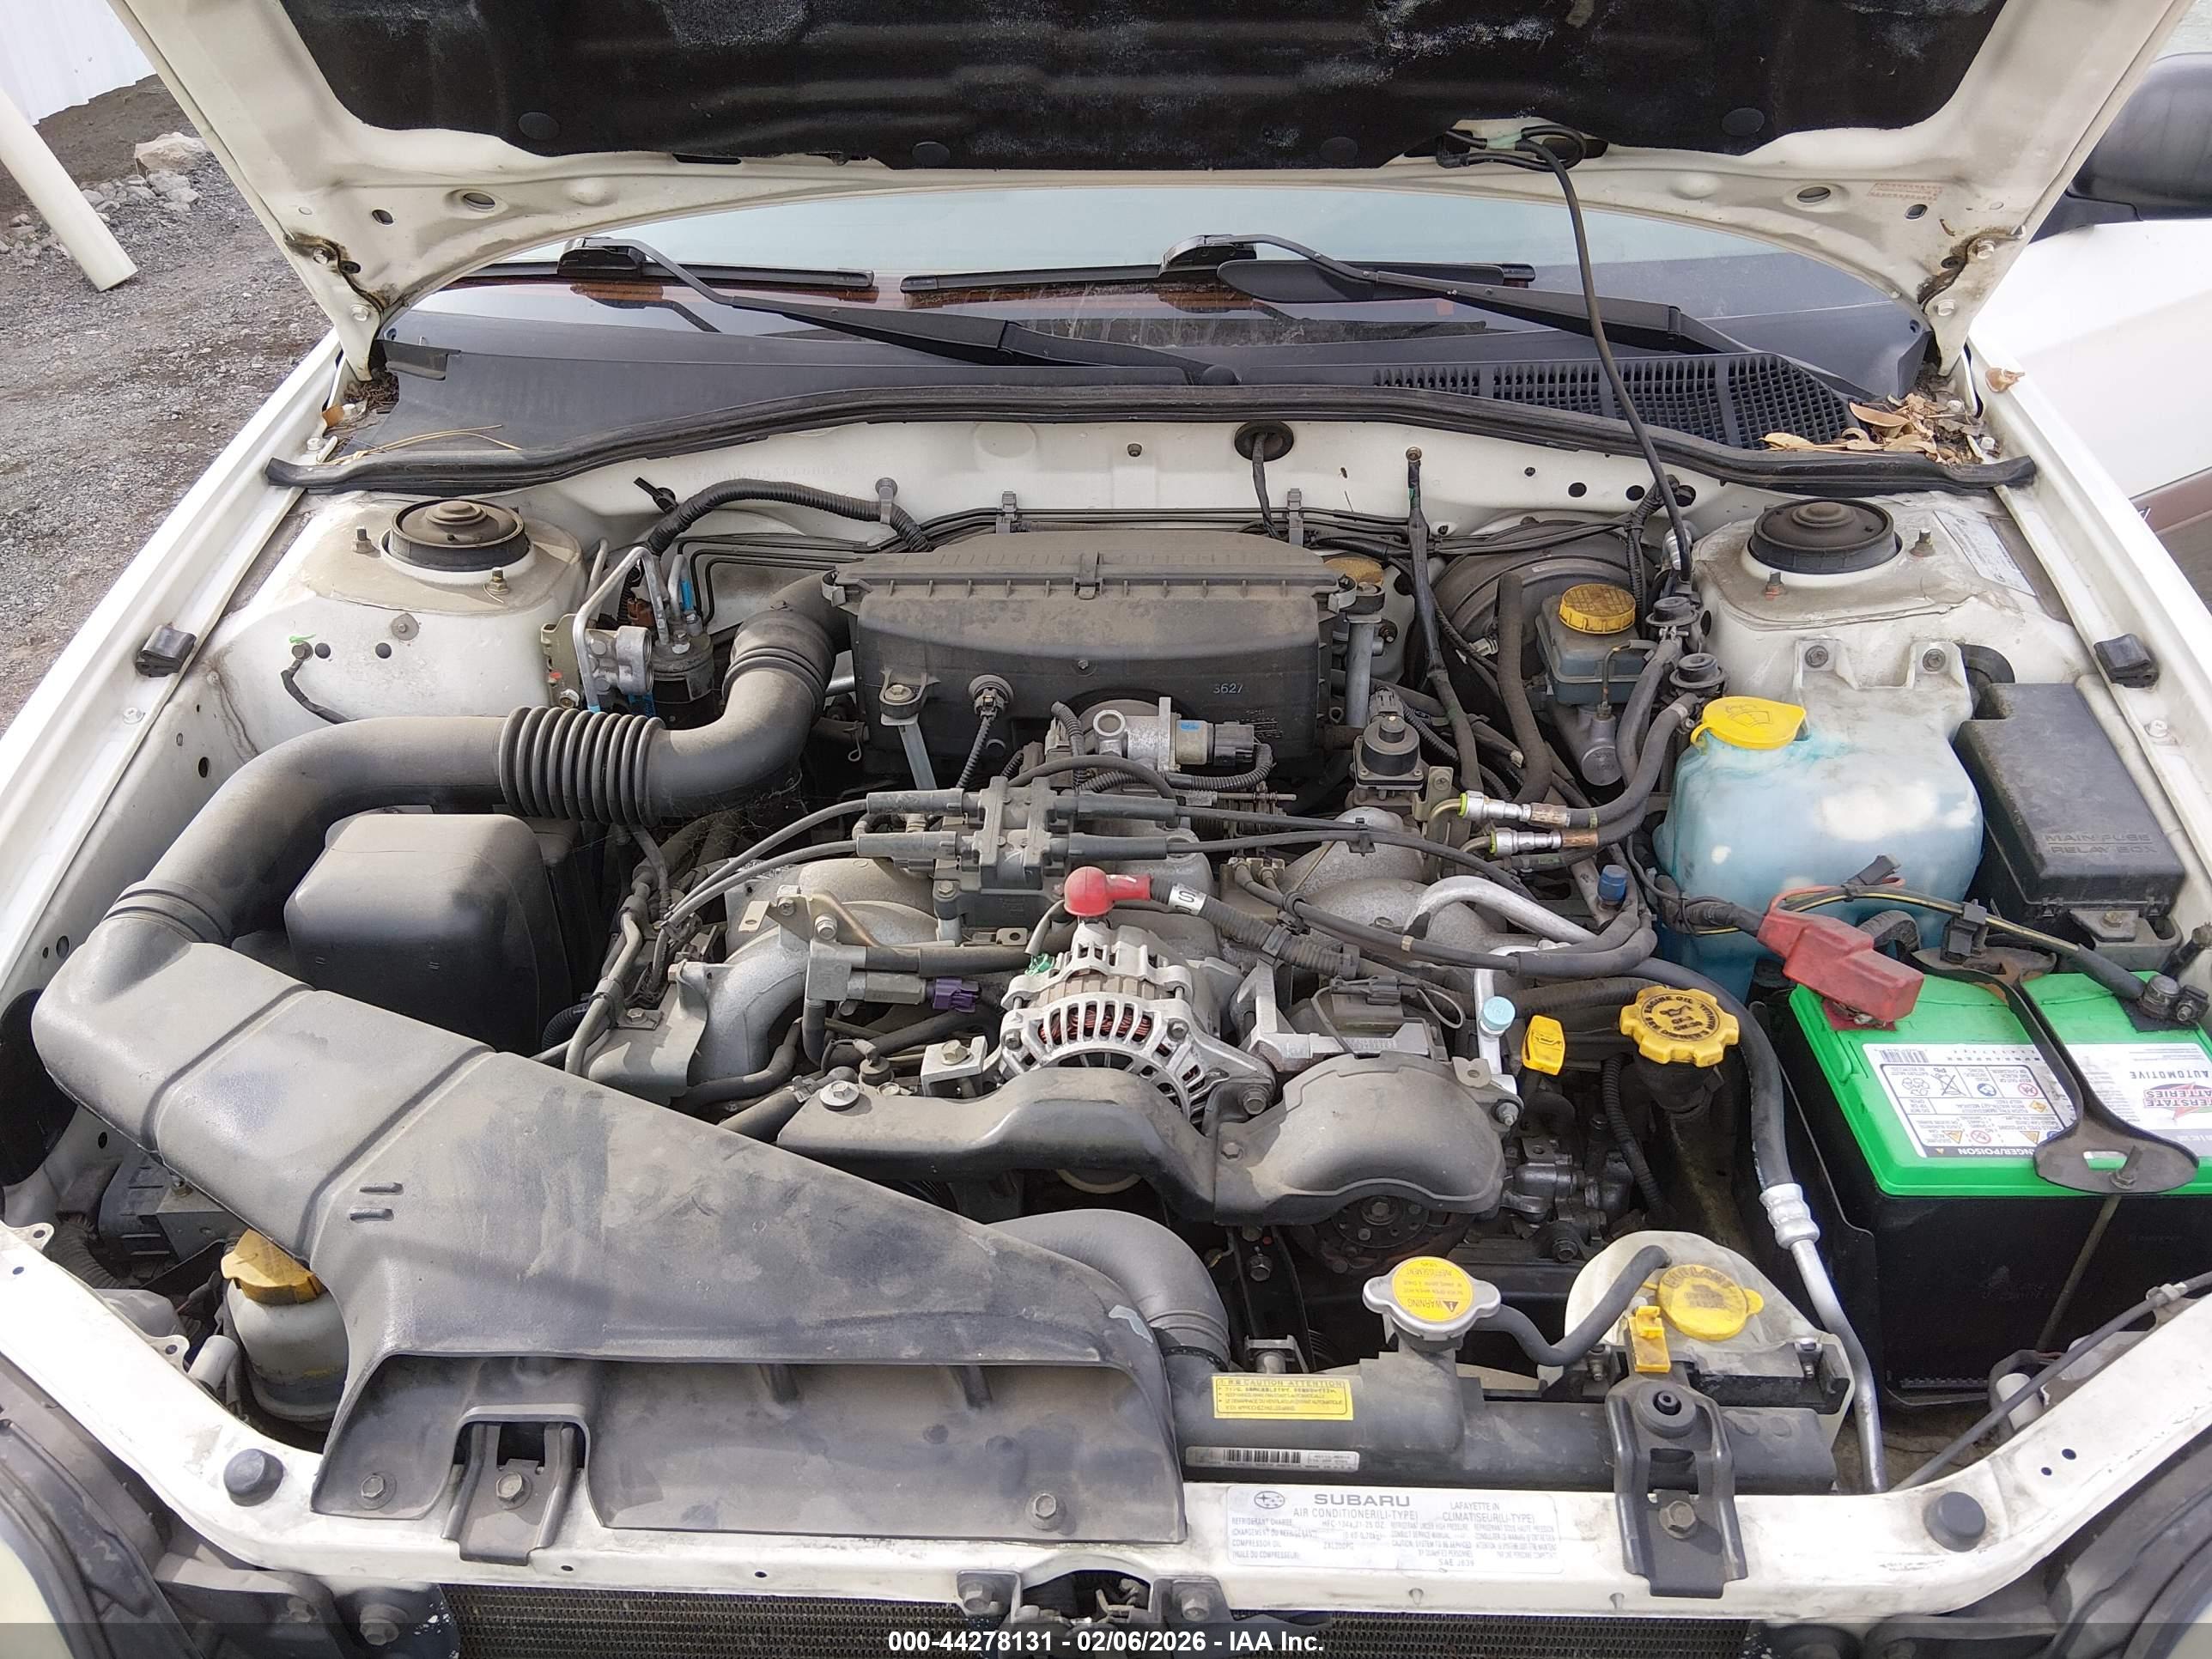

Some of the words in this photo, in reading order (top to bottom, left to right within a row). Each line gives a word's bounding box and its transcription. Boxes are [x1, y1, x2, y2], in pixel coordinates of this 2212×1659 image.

[2045, 833, 2096, 842] MAIN
[1644, 995, 1673, 1013] ENGINE
[1675, 995, 1693, 1005] OIL
[2129, 1069, 2209, 1079] AUTOMOTIVE
[2146, 1090, 2212, 1098] ATTERIES
[1957, 1147, 2035, 1156] NGER/POISON
[1407, 1297, 1443, 1309] WARNING
[1314, 1493, 1410, 1507] SUBARU
[1449, 1501, 1491, 1511] LAFAYETTE
[1492, 1503, 1500, 1511] IN
[1293, 1508, 1309, 1517] AIR
[1311, 1508, 1419, 1521] CONDITIONER(LI-TYPE)
